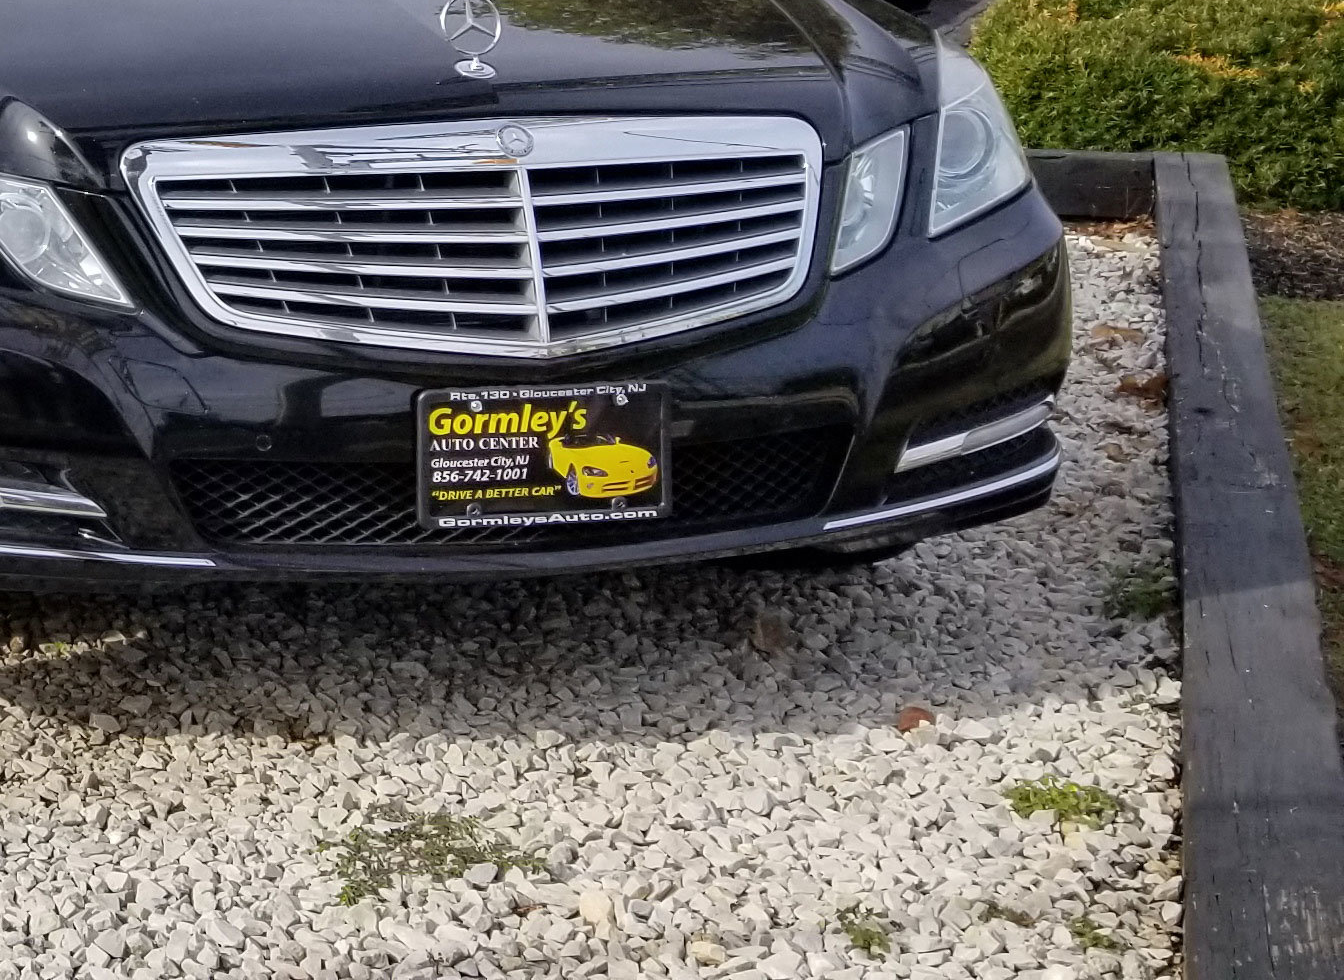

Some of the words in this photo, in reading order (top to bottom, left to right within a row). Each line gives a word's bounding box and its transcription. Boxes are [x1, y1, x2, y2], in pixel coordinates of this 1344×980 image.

[450, 392, 480, 402] Rte.
[483, 390, 510, 400] 130
[519, 387, 594, 399] Gloucester
[596, 385, 625, 397] City,
[628, 383, 647, 393] NJ
[428, 400, 587, 439] Gormley's
[430, 439, 475, 452] AUTO
[478, 436, 540, 450] CENTER
[431, 457, 489, 469] Gloucester
[490, 456, 514, 469] City,
[515, 454, 530, 465] NJ
[432, 468, 528, 483] 856-742-1001
[475, 489, 484, 499] A
[485, 487, 530, 499] BETTER
[438, 508, 658, 527] GormleysAuto.com
